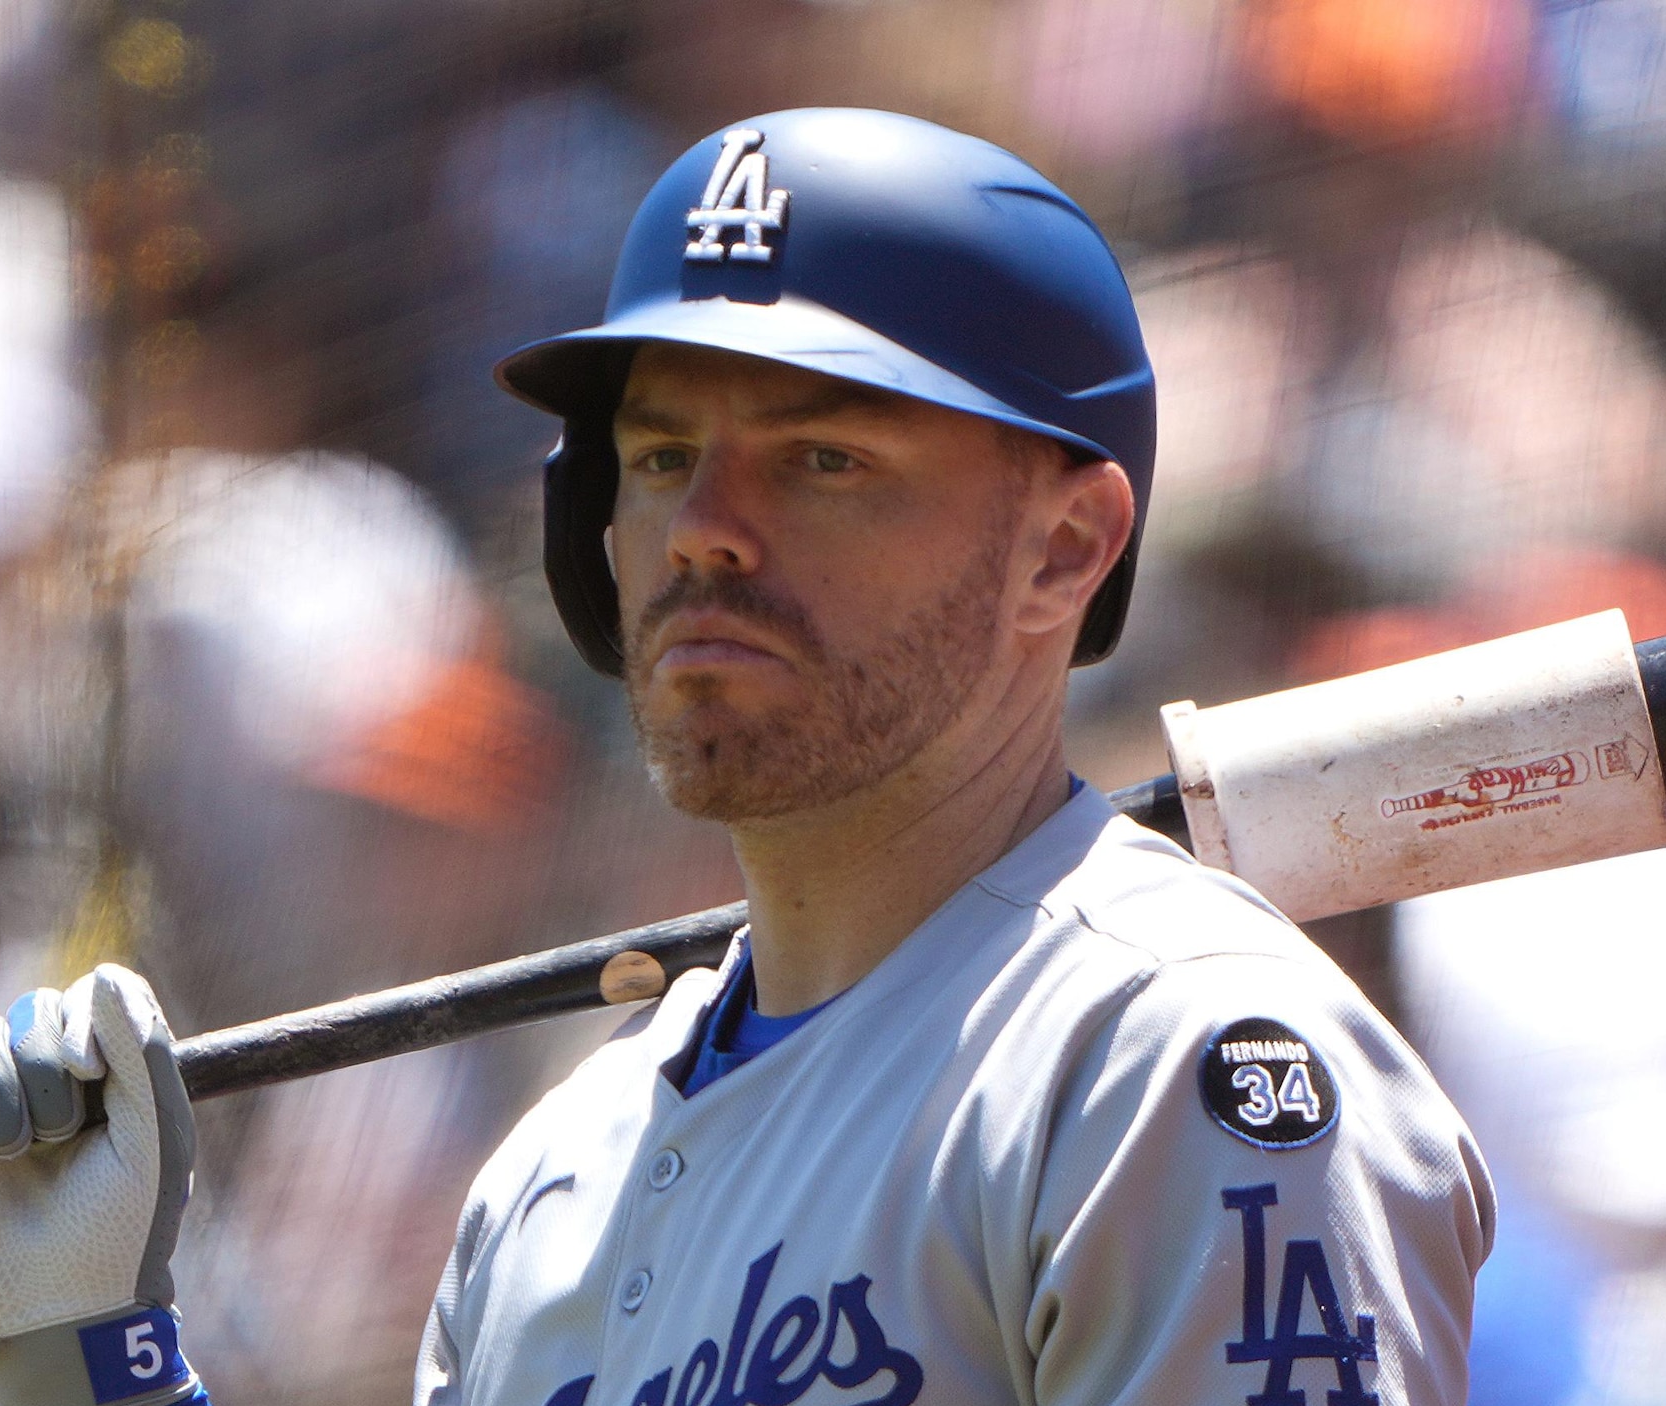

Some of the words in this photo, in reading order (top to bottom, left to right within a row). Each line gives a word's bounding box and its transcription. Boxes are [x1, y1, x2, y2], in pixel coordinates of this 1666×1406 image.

[683, 128, 791, 263] LA
[1220, 1040, 1309, 1065] FERNANDO
[1231, 1062, 1321, 1126] 34
[125, 1321, 163, 1379] 5
